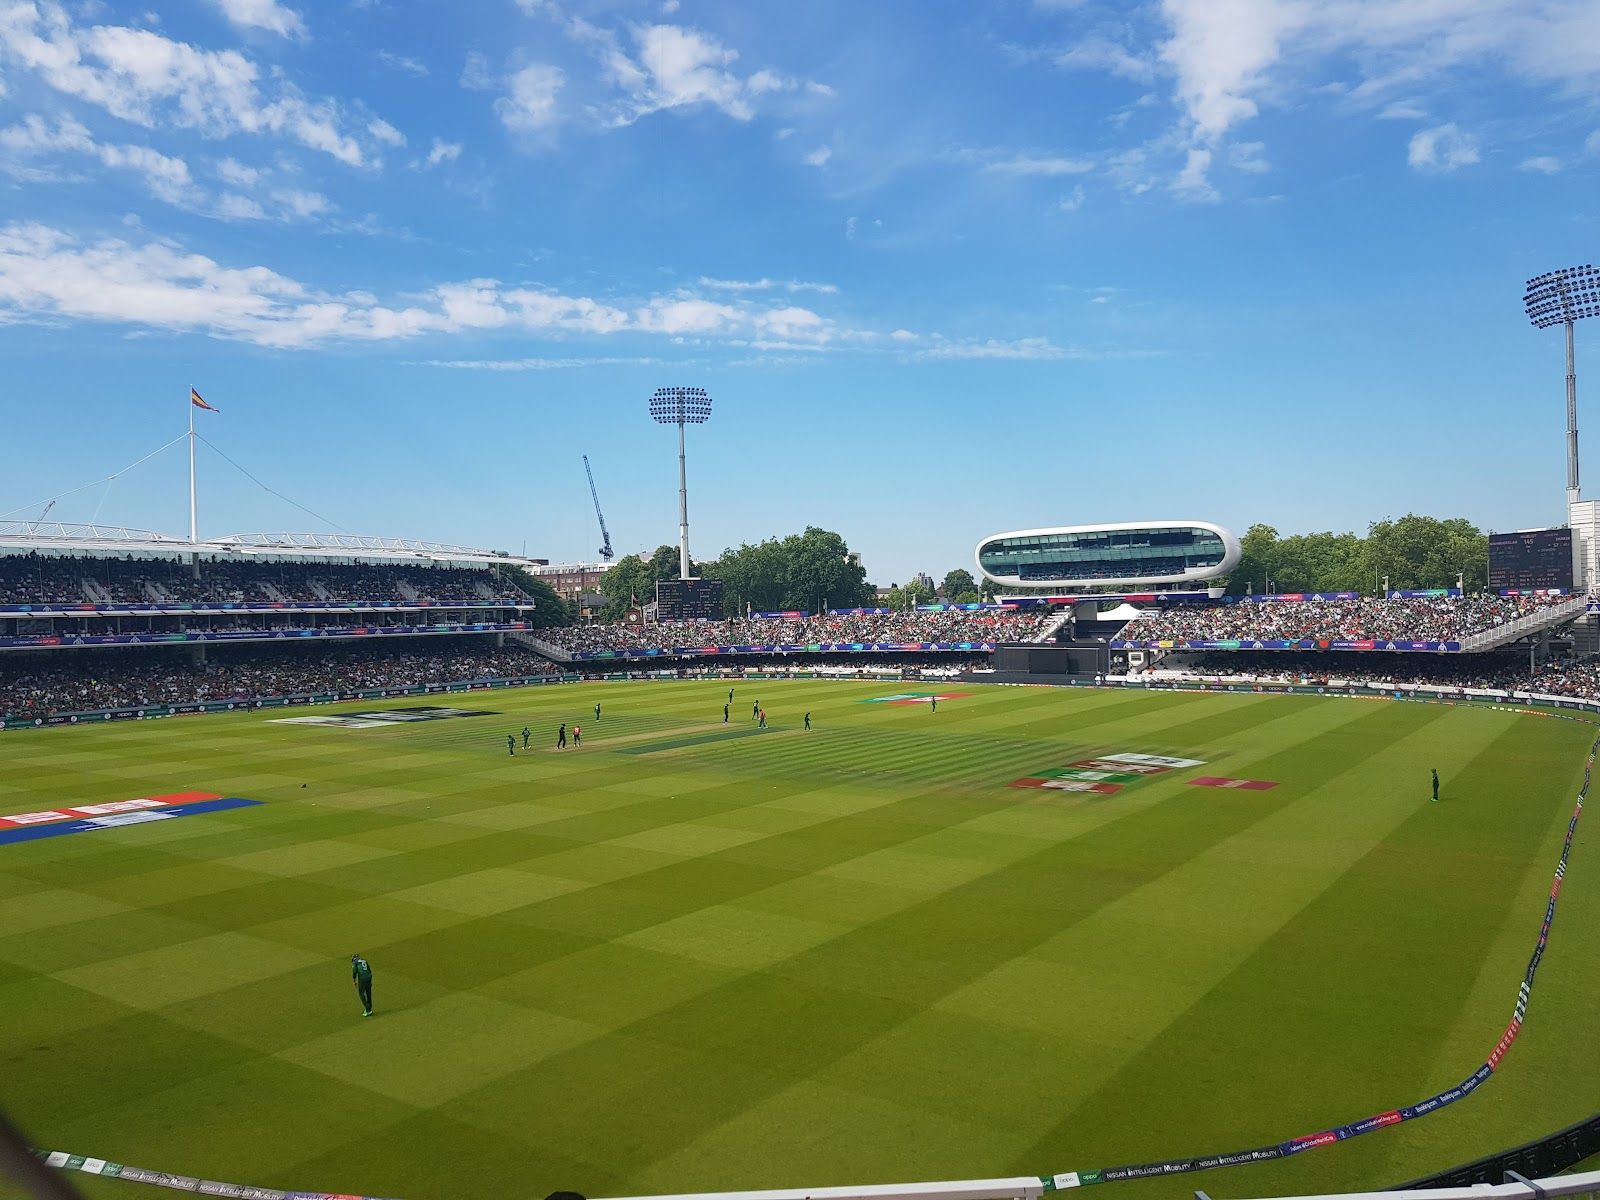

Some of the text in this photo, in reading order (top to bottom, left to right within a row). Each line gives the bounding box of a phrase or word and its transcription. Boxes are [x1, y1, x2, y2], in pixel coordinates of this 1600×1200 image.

[1198, 1149, 1278, 1168] NISSAN INTELLIGENT MOBILITY
[121, 1170, 139, 1178] NISSAN
[170, 1178, 195, 1188] MOBILITY
[1106, 1162, 1191, 1180] NISSAN INTELLIGENT MOBILITY
